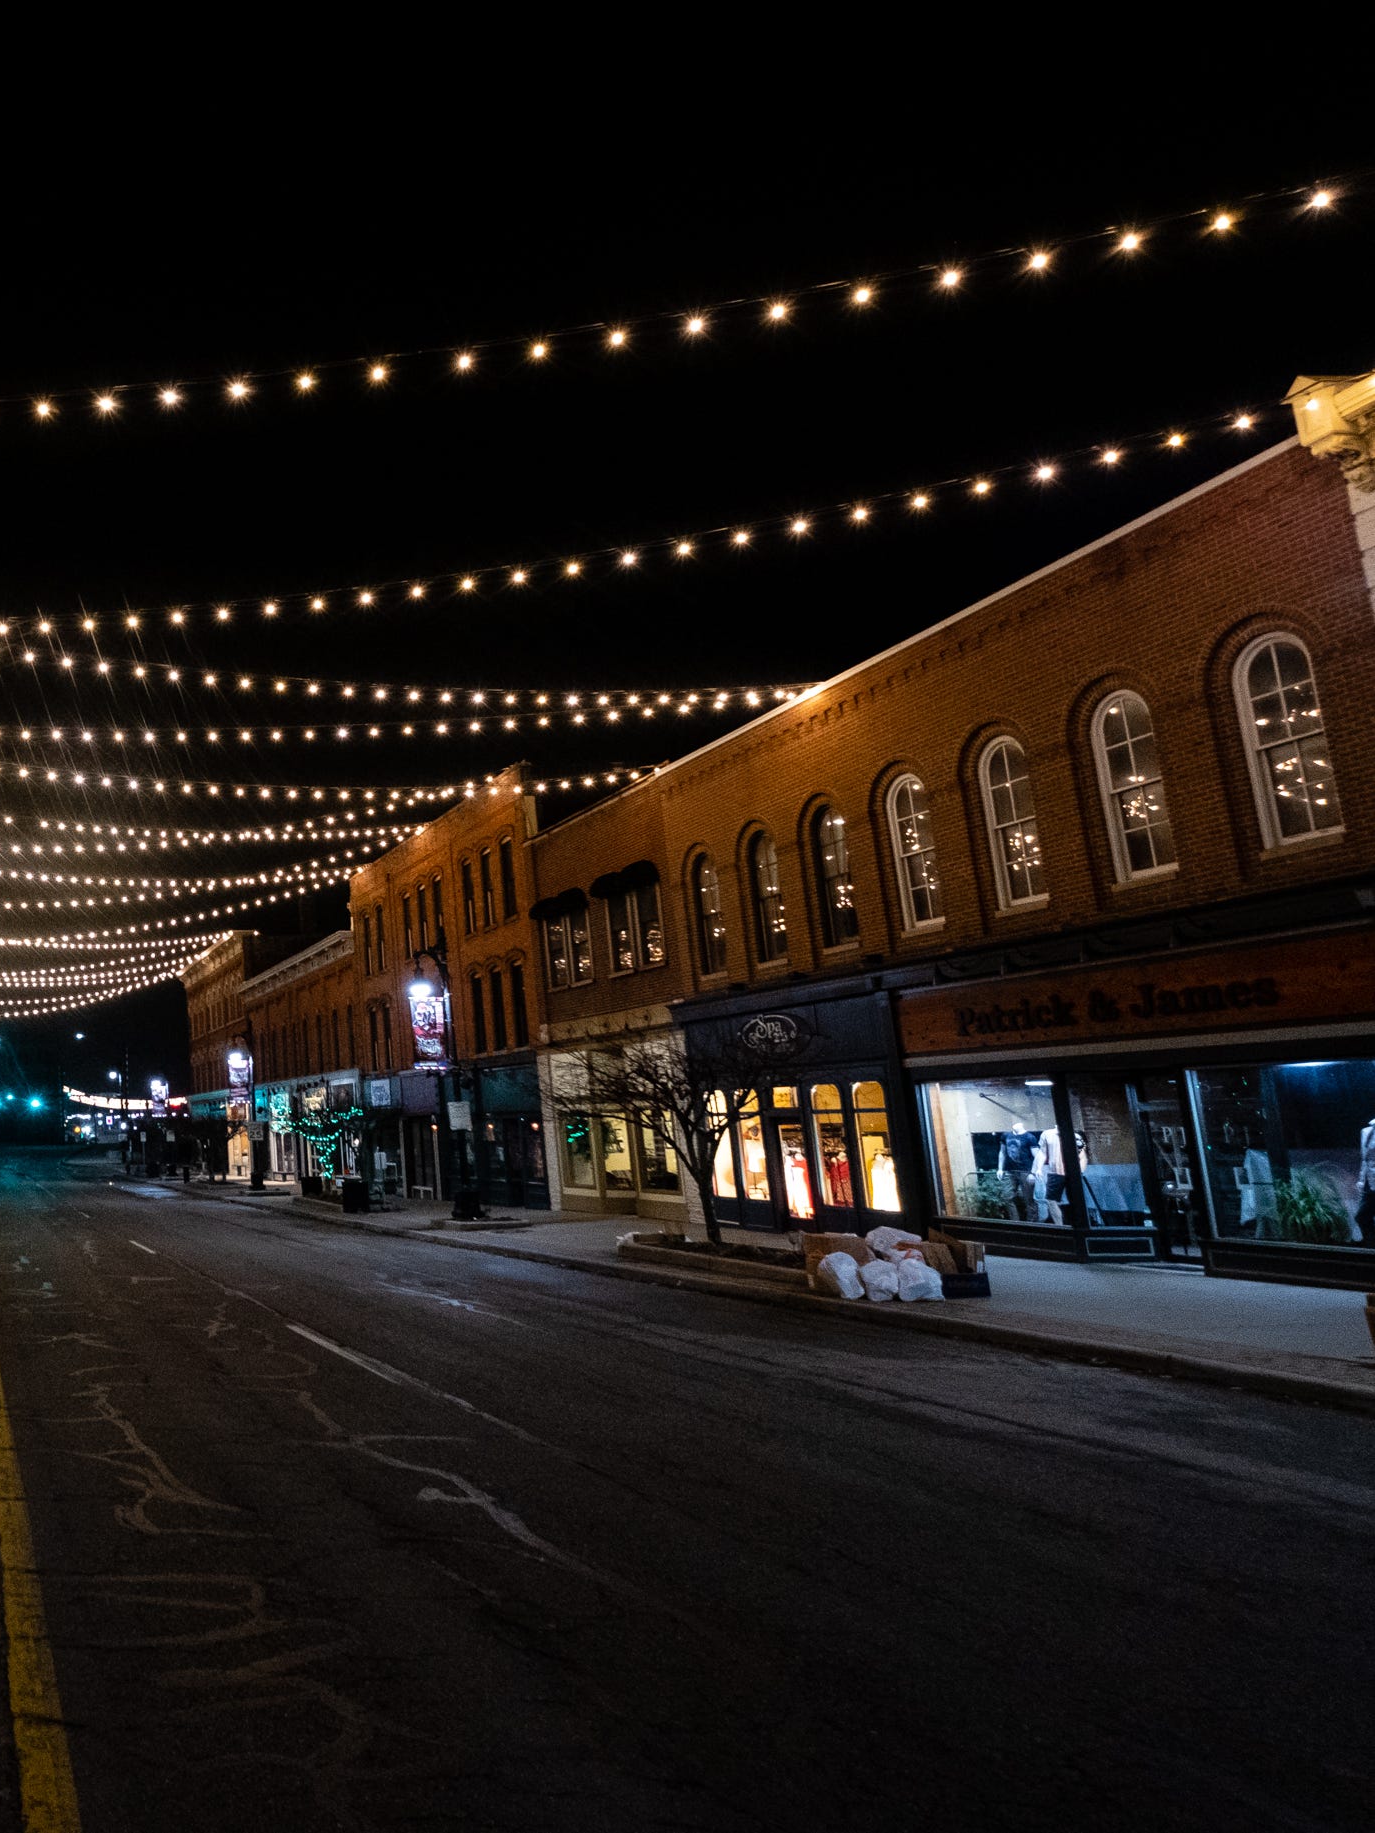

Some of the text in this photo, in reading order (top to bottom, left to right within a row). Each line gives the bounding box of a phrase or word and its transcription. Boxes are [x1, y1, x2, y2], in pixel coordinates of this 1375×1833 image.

[954, 976, 1281, 1036] Patrick & James
[755, 1014, 782, 1039] Spa
[249, 1131, 263, 1139] 25
